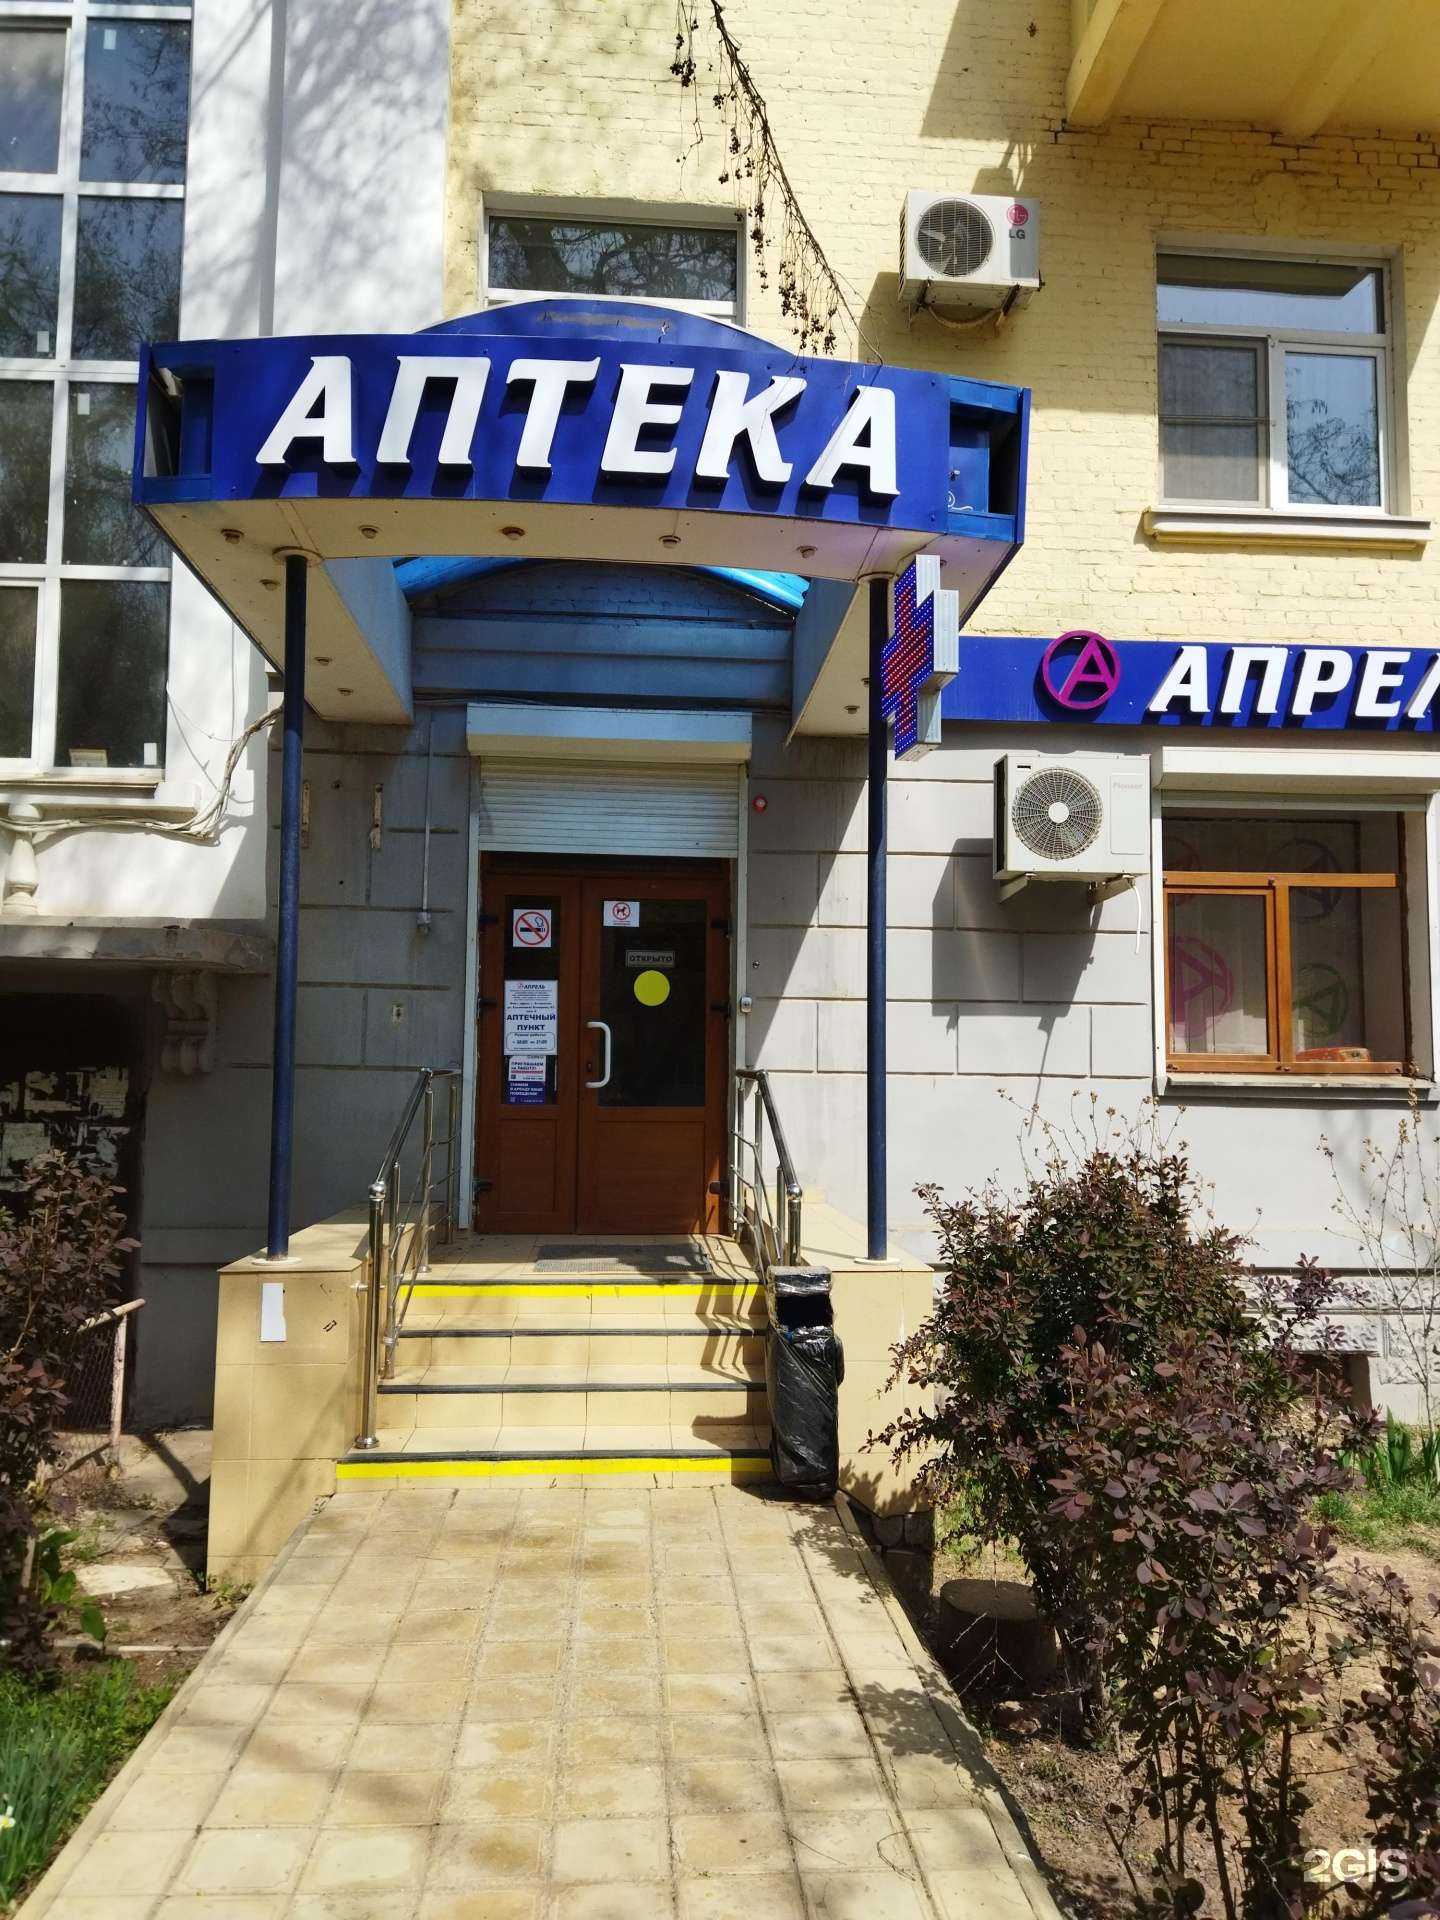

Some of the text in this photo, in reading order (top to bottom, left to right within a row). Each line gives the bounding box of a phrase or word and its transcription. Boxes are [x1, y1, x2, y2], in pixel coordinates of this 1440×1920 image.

[1008, 229, 1026, 239] LG
[255, 355, 900, 495] АПТЕКА
[506, 1013, 556, 1021] АПТЕЧНЫЙ
